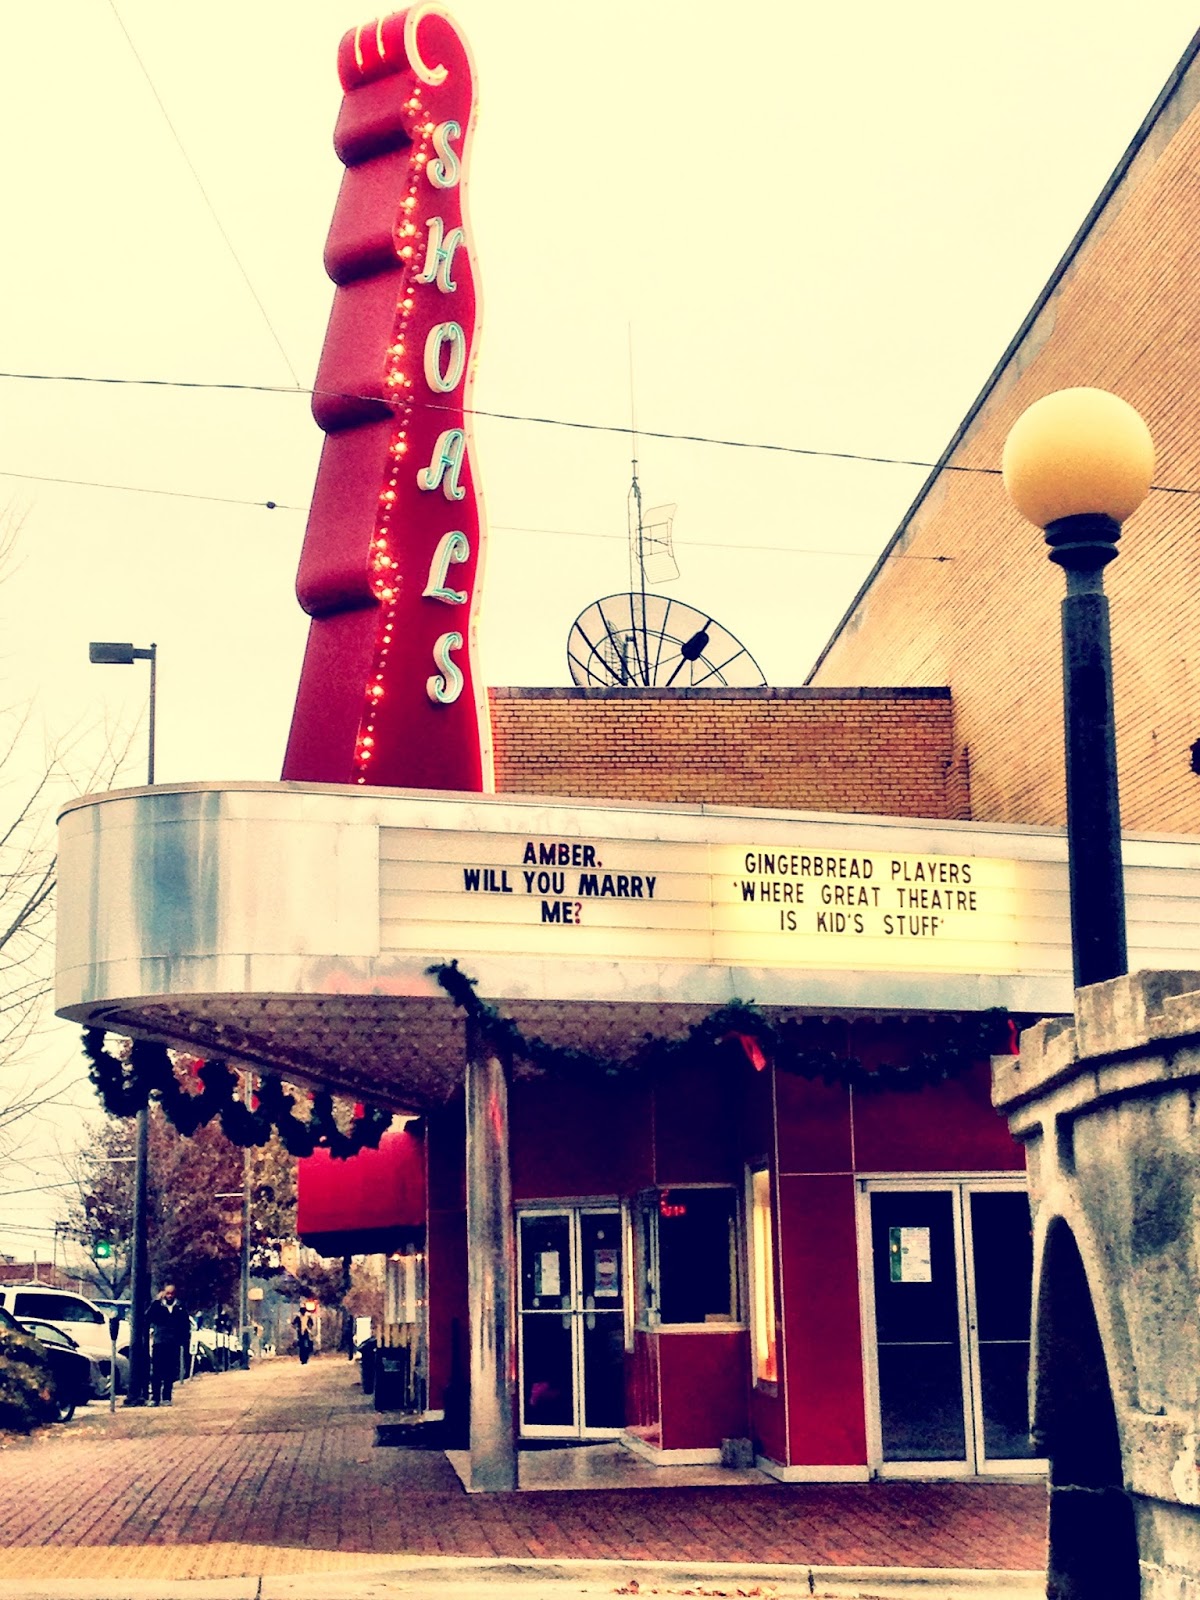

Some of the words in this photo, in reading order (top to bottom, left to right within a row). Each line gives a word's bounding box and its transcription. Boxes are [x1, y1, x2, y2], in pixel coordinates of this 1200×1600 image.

[416, 120, 469, 705] SHOALS
[745, 852, 873, 879] GINGERBREAD
[891, 860, 972, 883] PLAYERS
[463, 868, 513, 893] WILL
[523, 871, 565, 894] YOU
[578, 873, 656, 898] MARRY
[821, 884, 881, 907] GREAT
[896, 888, 977, 911] THEATRE
[541, 900, 582, 924] ME?
[780, 910, 797, 931] IS
[817, 912, 864, 934] KID'S
